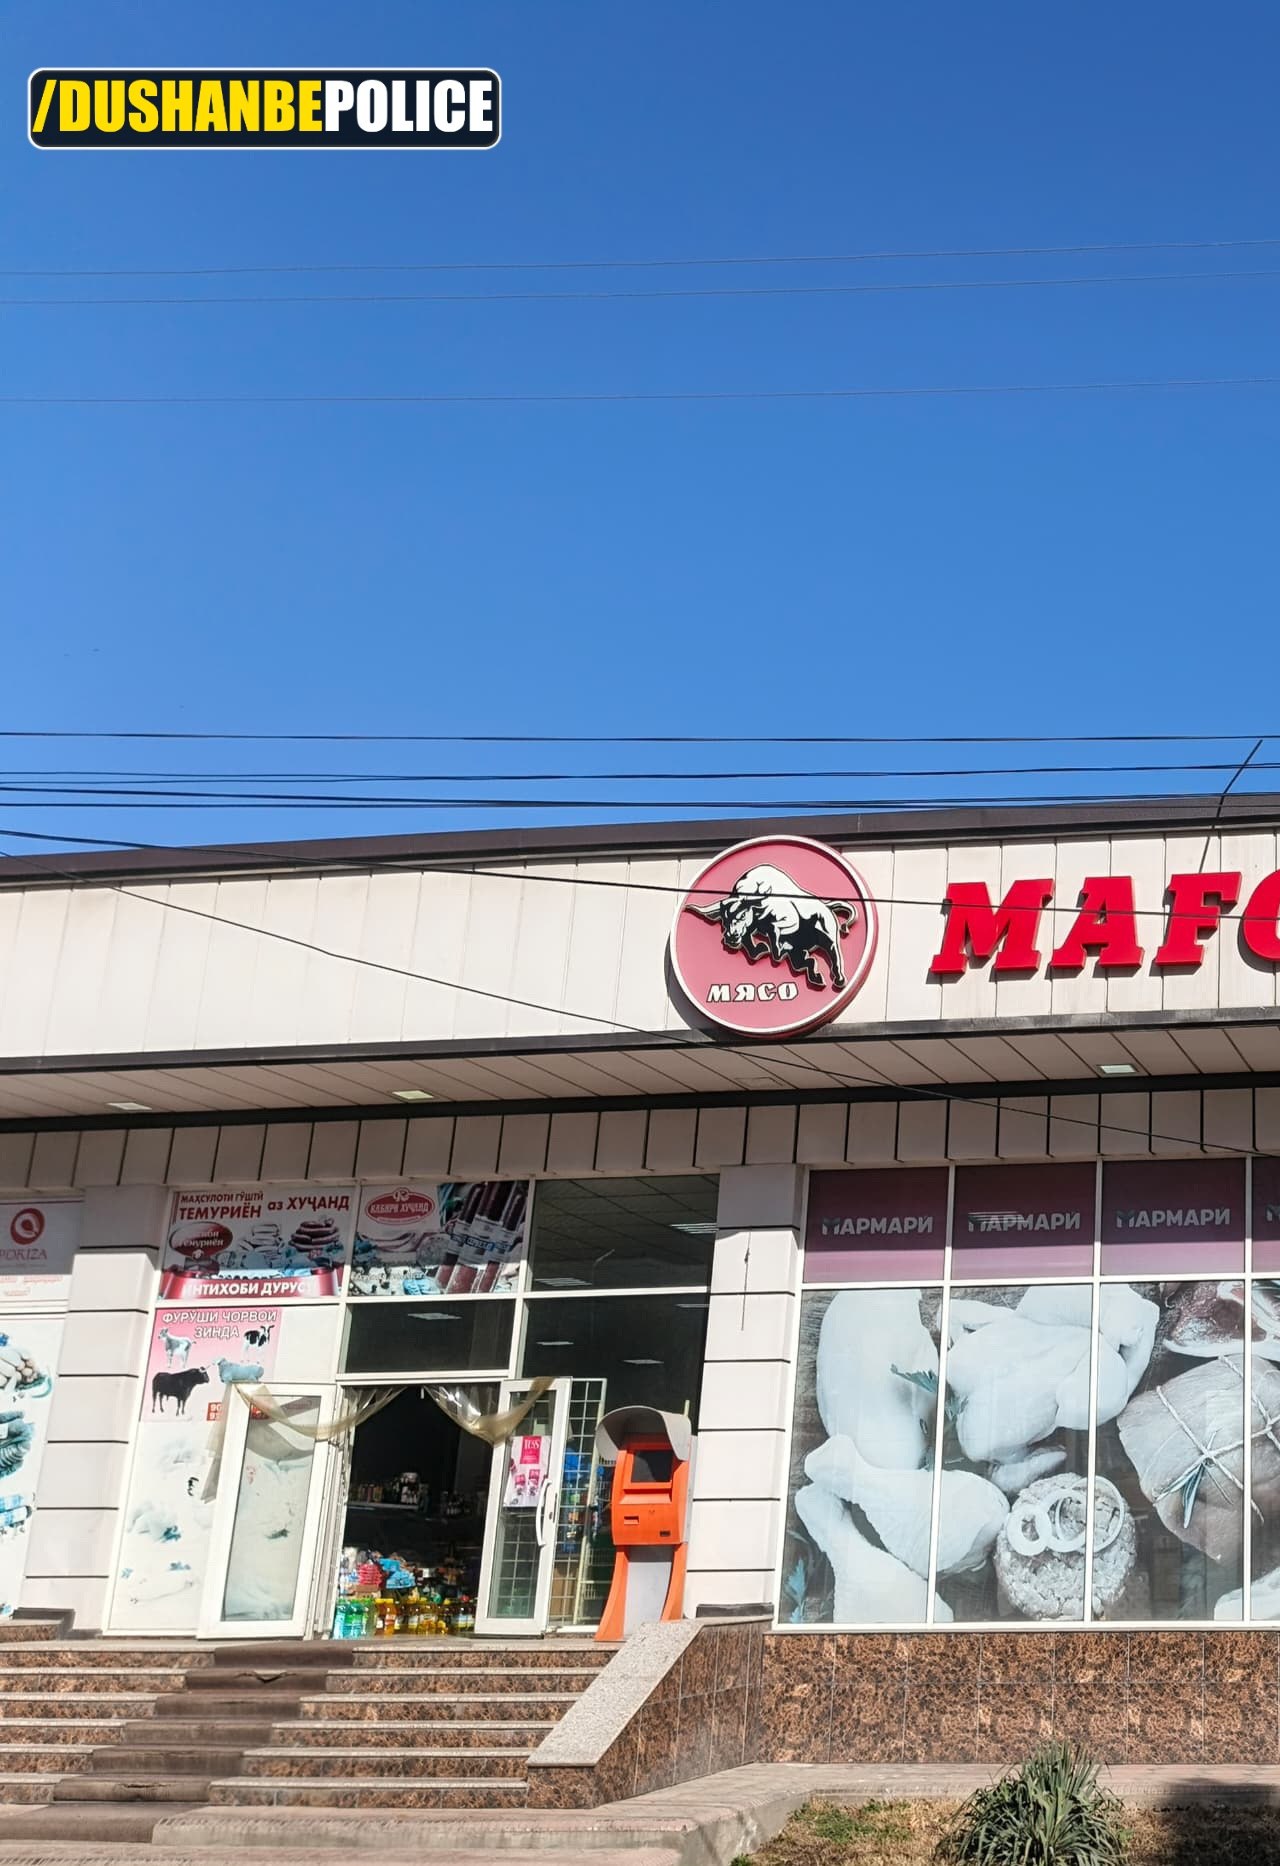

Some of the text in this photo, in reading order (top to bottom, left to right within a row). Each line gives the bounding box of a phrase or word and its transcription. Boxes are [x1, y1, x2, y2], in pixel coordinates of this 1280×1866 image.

[706, 982, 800, 1004] МЯСО
[179, 1202, 262, 1220] ТЕМУРИЁН
[260, 1281, 313, 1297] ДУРУС
[194, 1326, 240, 1340] ЗИНДА
